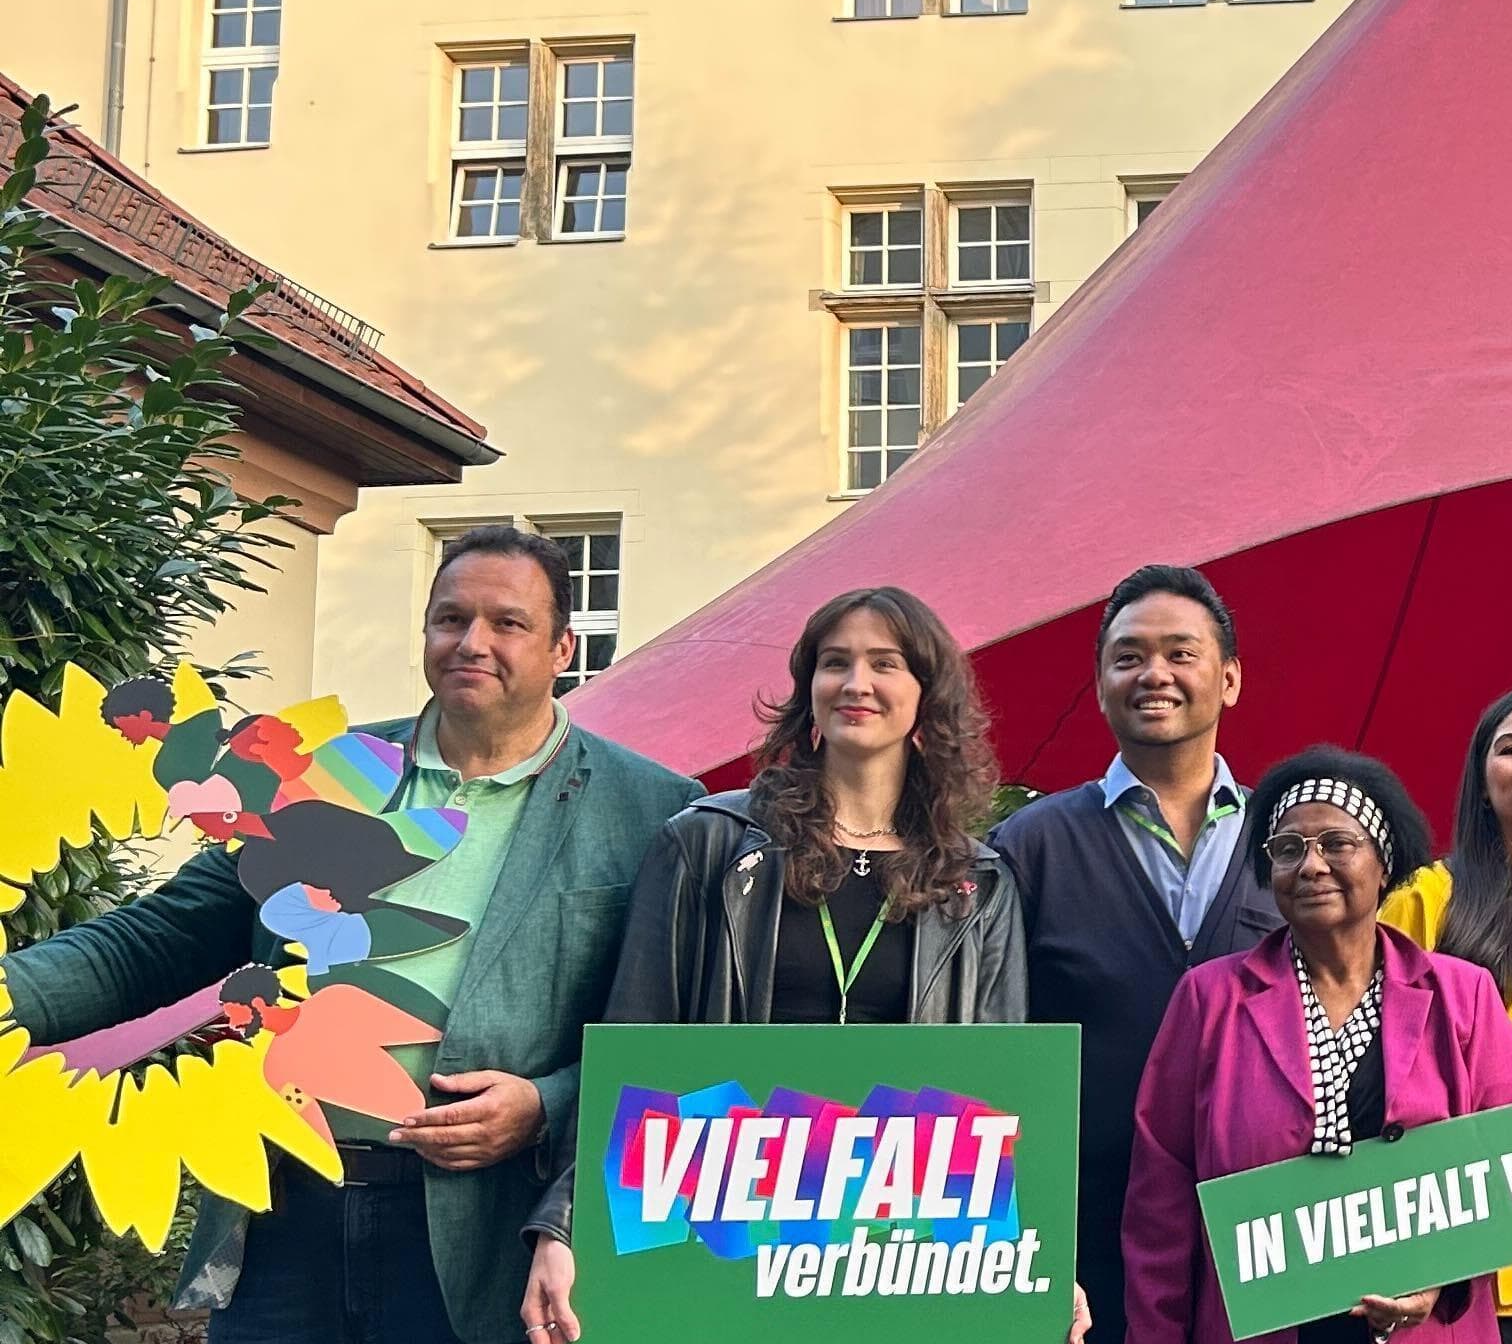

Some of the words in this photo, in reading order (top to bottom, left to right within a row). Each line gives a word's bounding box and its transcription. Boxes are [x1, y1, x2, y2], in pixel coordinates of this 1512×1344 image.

[642, 1116, 1018, 1222] VIELFALT
[1235, 1215, 1287, 1283] IN
[1295, 1160, 1491, 1264] VIELFALT
[756, 1225, 1051, 1298] verbündet.
